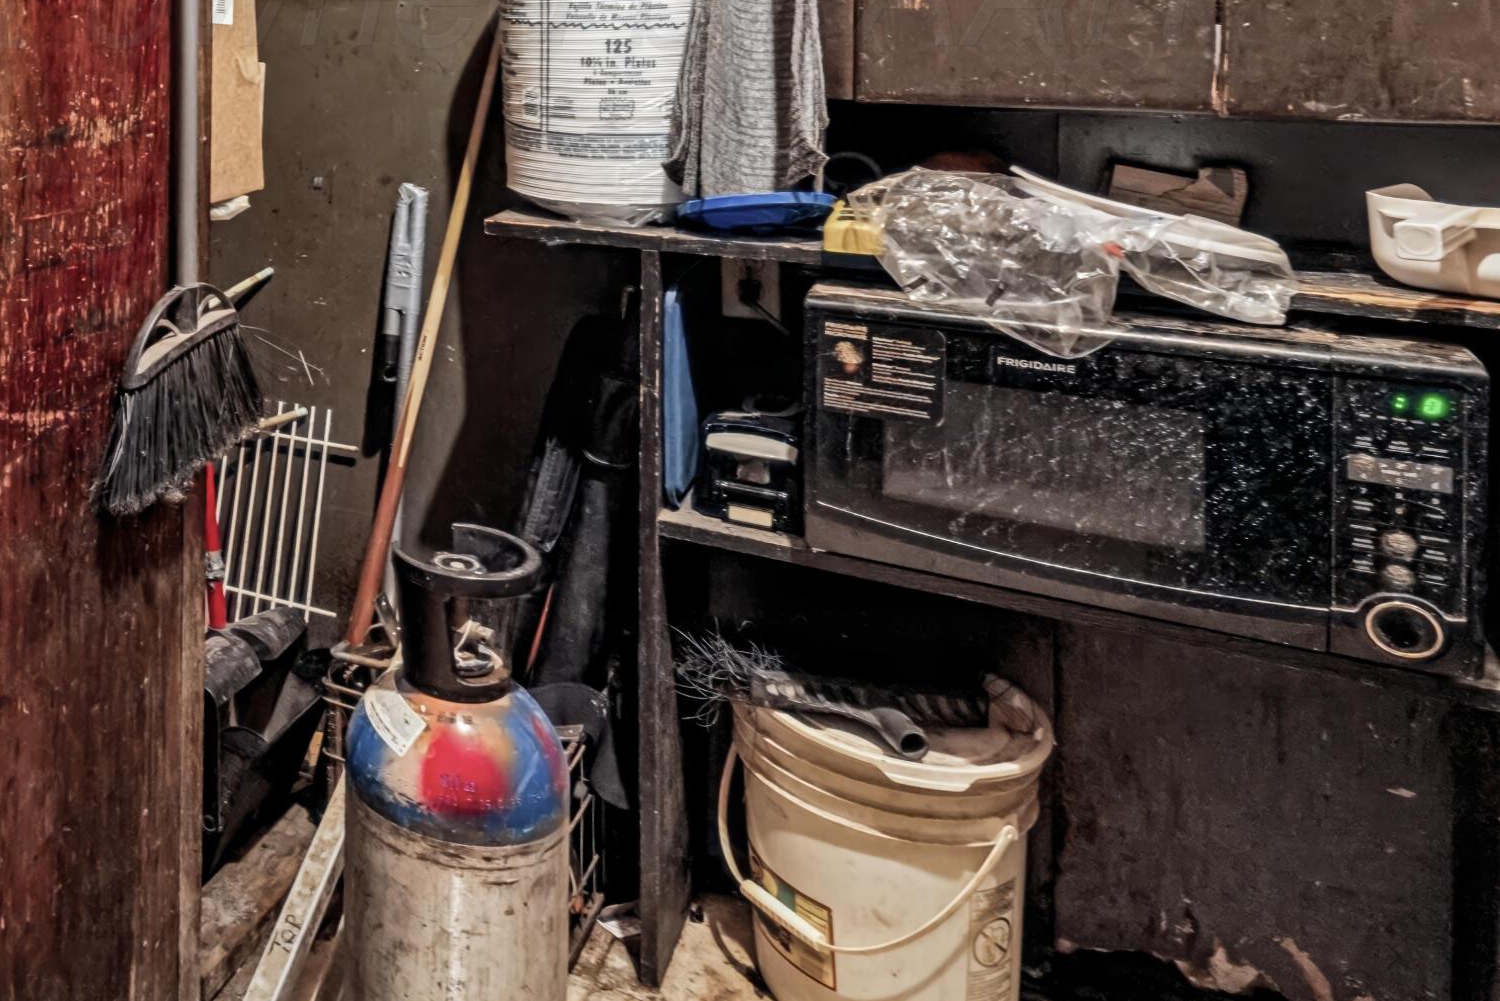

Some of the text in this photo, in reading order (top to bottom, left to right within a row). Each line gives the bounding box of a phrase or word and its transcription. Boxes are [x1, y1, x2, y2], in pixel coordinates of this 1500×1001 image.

[605, 38, 632, 54] 125
[625, 56, 656, 68] Plates
[997, 356, 1076, 374] FRIGIDAIRE
